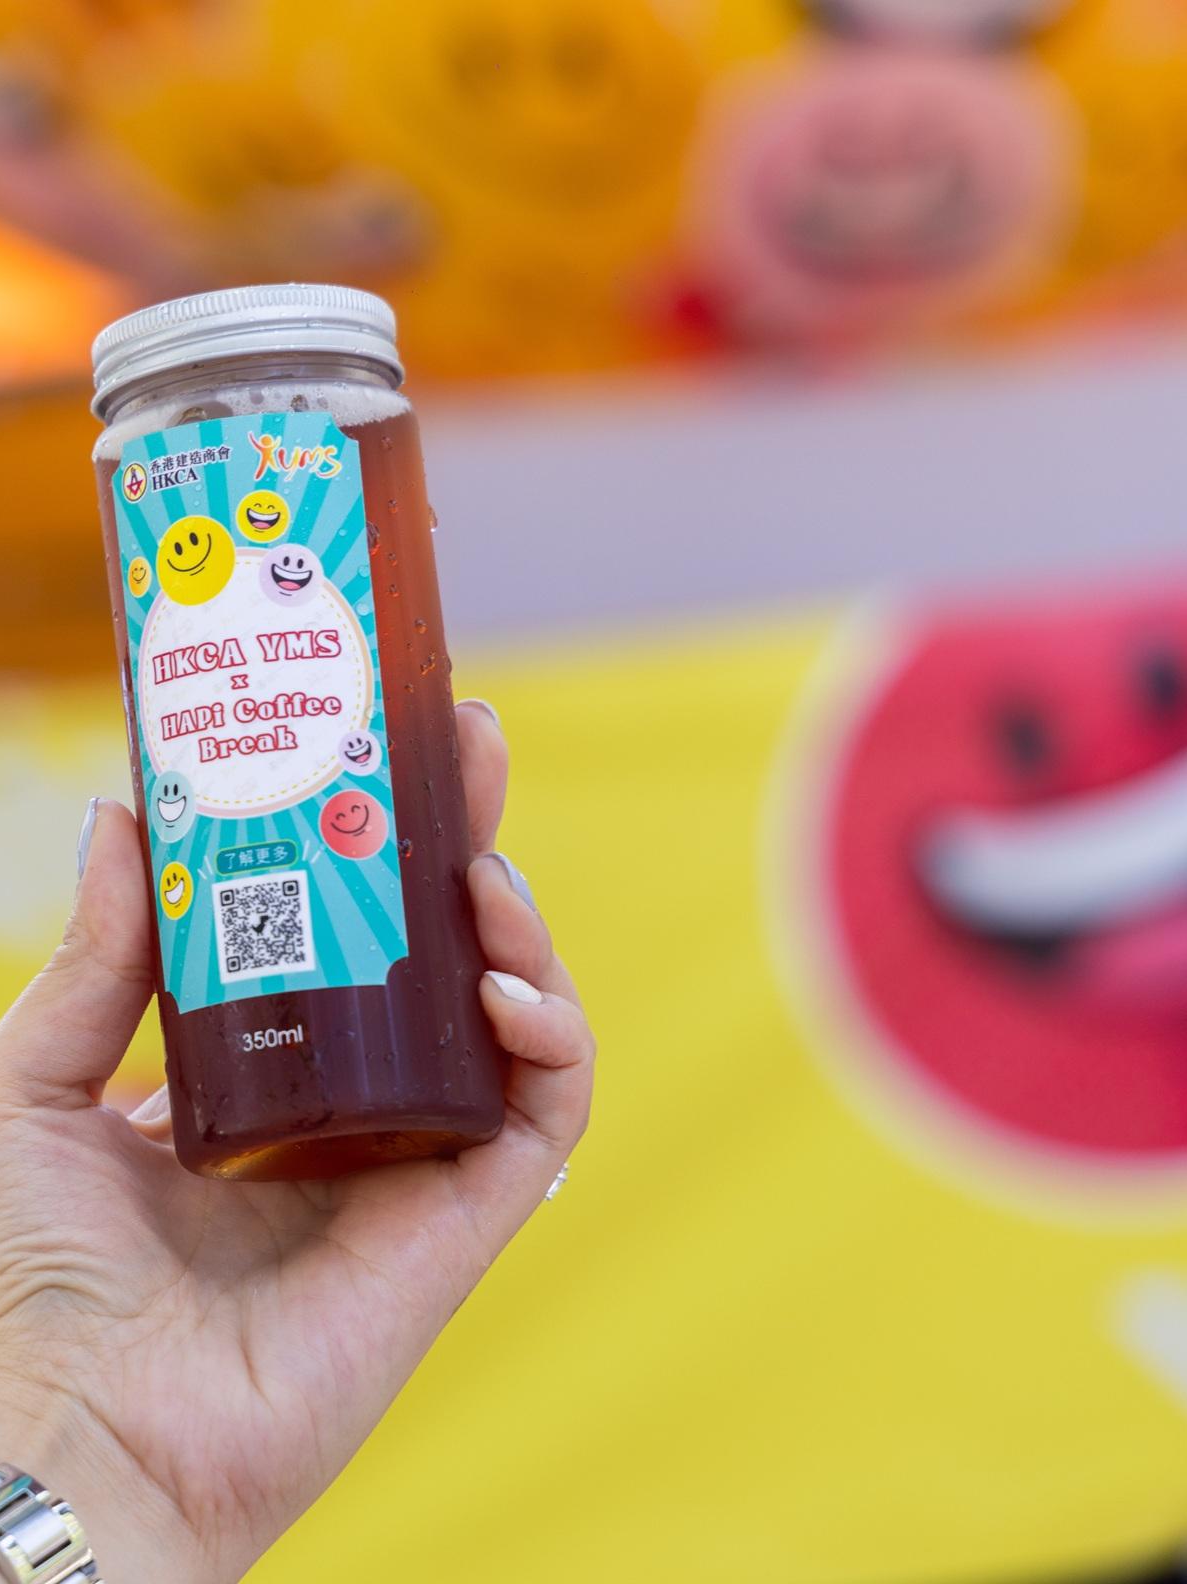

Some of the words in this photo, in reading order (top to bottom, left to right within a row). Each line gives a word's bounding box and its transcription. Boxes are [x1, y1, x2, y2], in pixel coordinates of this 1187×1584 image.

[149, 446, 230, 475] 香港建造商會
[151, 468, 198, 491] HKCA
[152, 638, 247, 684] HKCA
[257, 629, 341, 662] YMS
[161, 702, 225, 741] HAPi
[233, 692, 342, 723] Coffee
[198, 725, 298, 763] Break
[223, 846, 288, 870] 了解更多
[242, 1024, 304, 1052] 350ml
